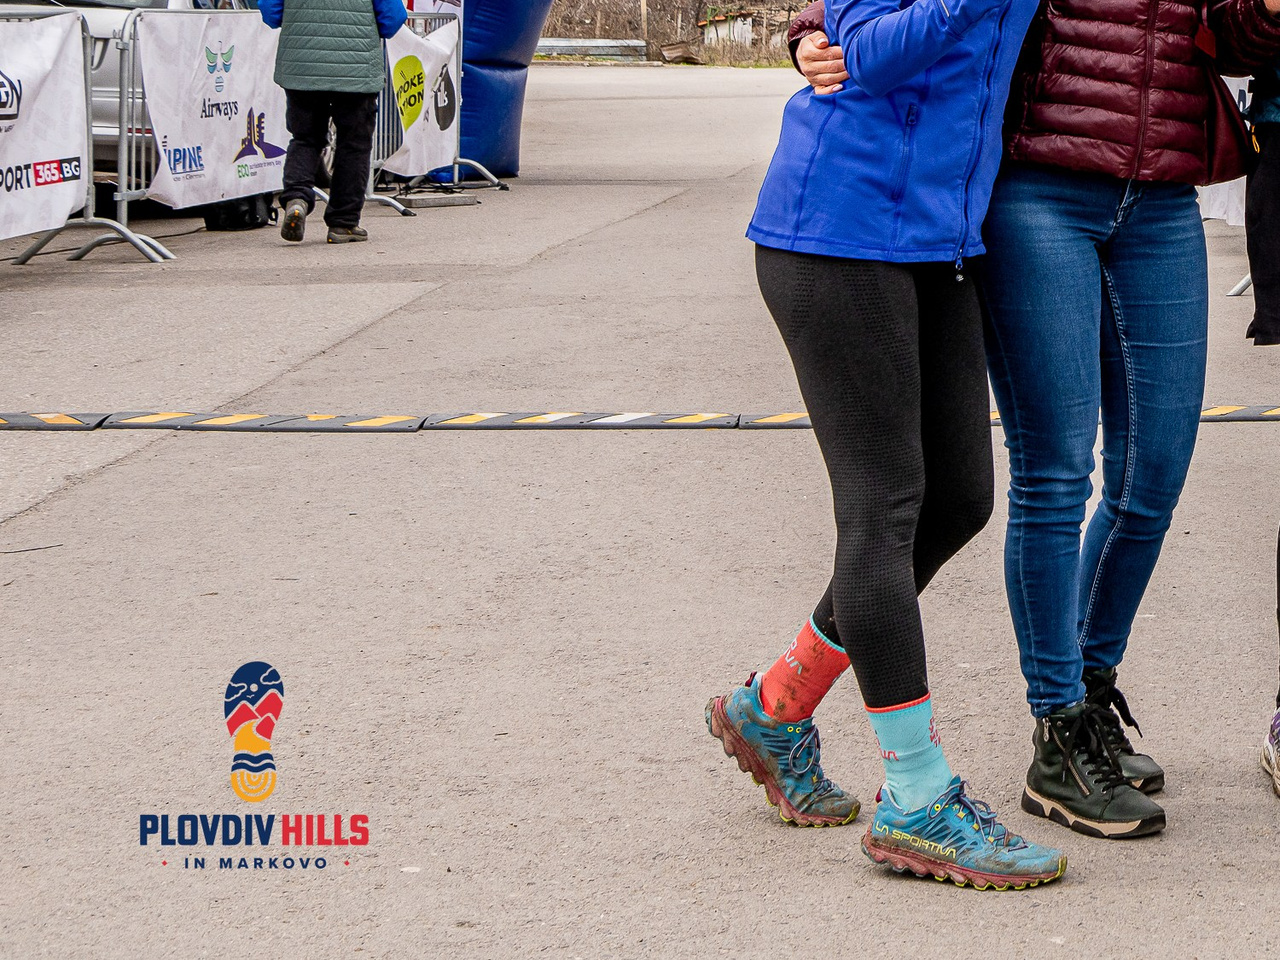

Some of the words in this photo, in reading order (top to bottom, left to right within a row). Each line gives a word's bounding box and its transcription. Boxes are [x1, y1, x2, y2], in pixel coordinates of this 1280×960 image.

[200, 98, 239, 120] Airways
[875, 821, 889, 835] LA
[892, 829, 956, 858] SPORTIVA
